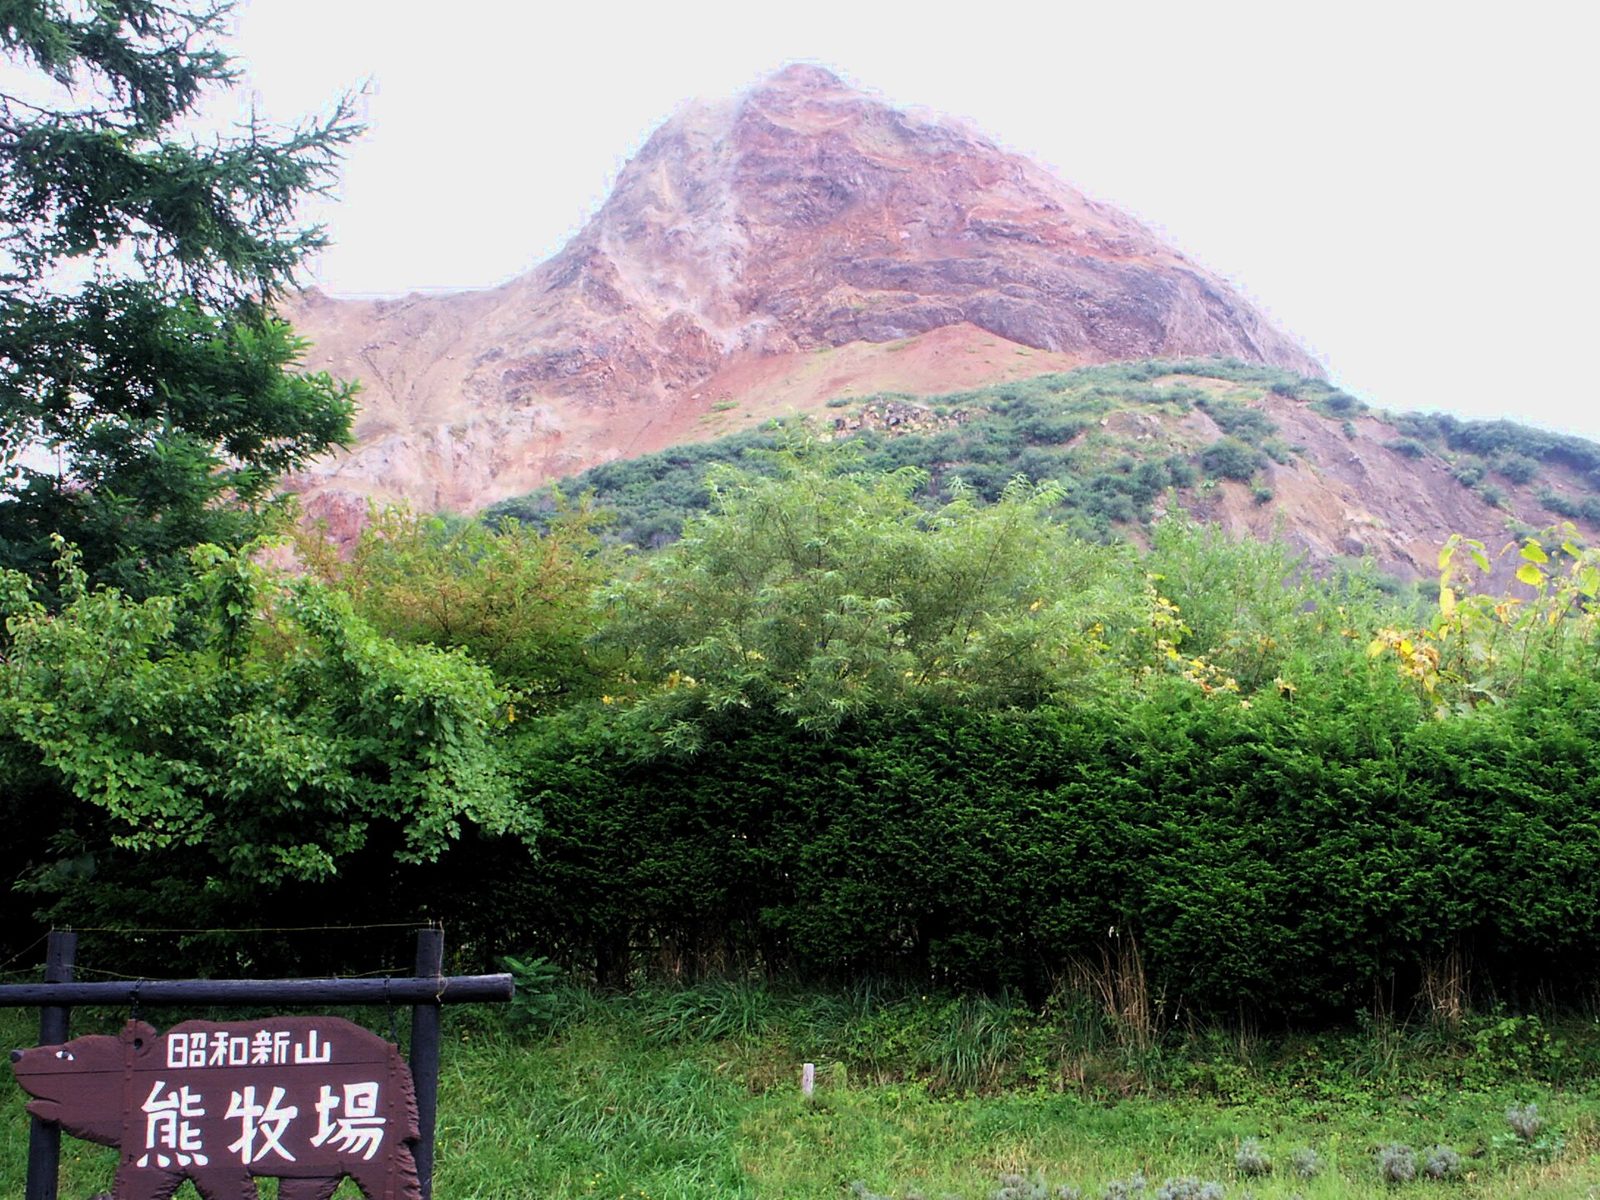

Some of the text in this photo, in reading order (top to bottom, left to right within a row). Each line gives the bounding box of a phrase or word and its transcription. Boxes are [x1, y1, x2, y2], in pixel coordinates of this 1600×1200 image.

[166, 1029, 332, 1068] 昭和新山
[136, 1080, 387, 1168] 熊牧場
